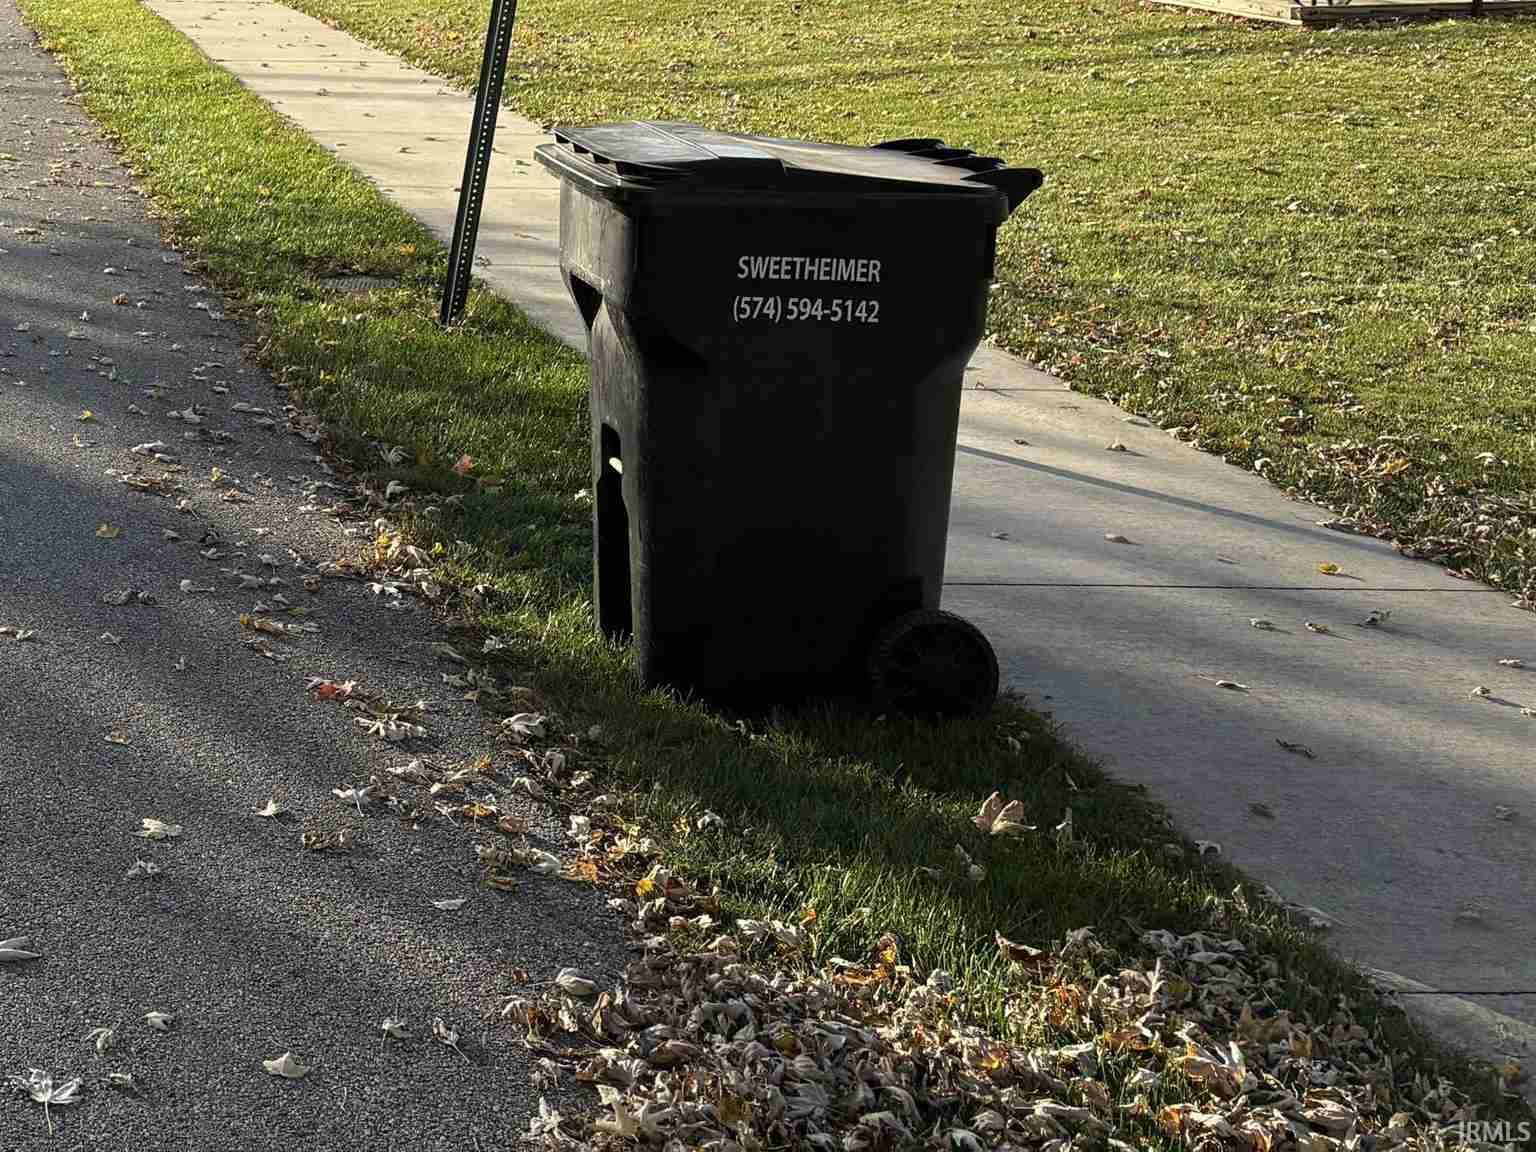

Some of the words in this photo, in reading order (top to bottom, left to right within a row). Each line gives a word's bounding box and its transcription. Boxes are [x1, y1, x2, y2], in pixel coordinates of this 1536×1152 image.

[737, 255, 882, 283] SWEETHEIMER
[733, 295, 783, 323] (574)
[786, 297, 880, 323] 594-5142
